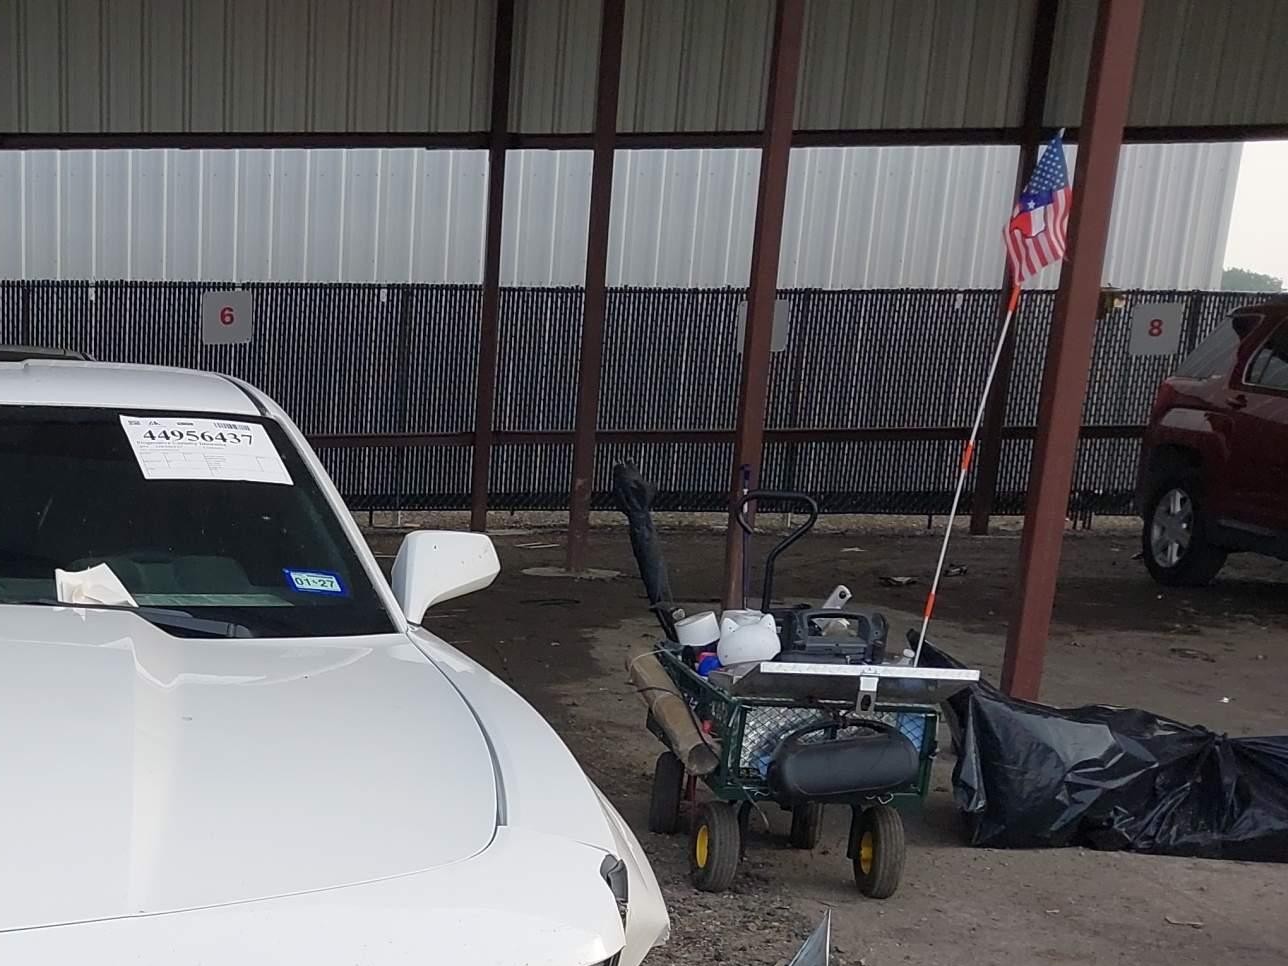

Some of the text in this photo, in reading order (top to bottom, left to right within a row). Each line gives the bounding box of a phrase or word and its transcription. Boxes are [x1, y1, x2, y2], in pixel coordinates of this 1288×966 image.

[219, 306, 235, 326] 6
[1147, 318, 1163, 337] 8
[143, 429, 253, 445] 44956437
